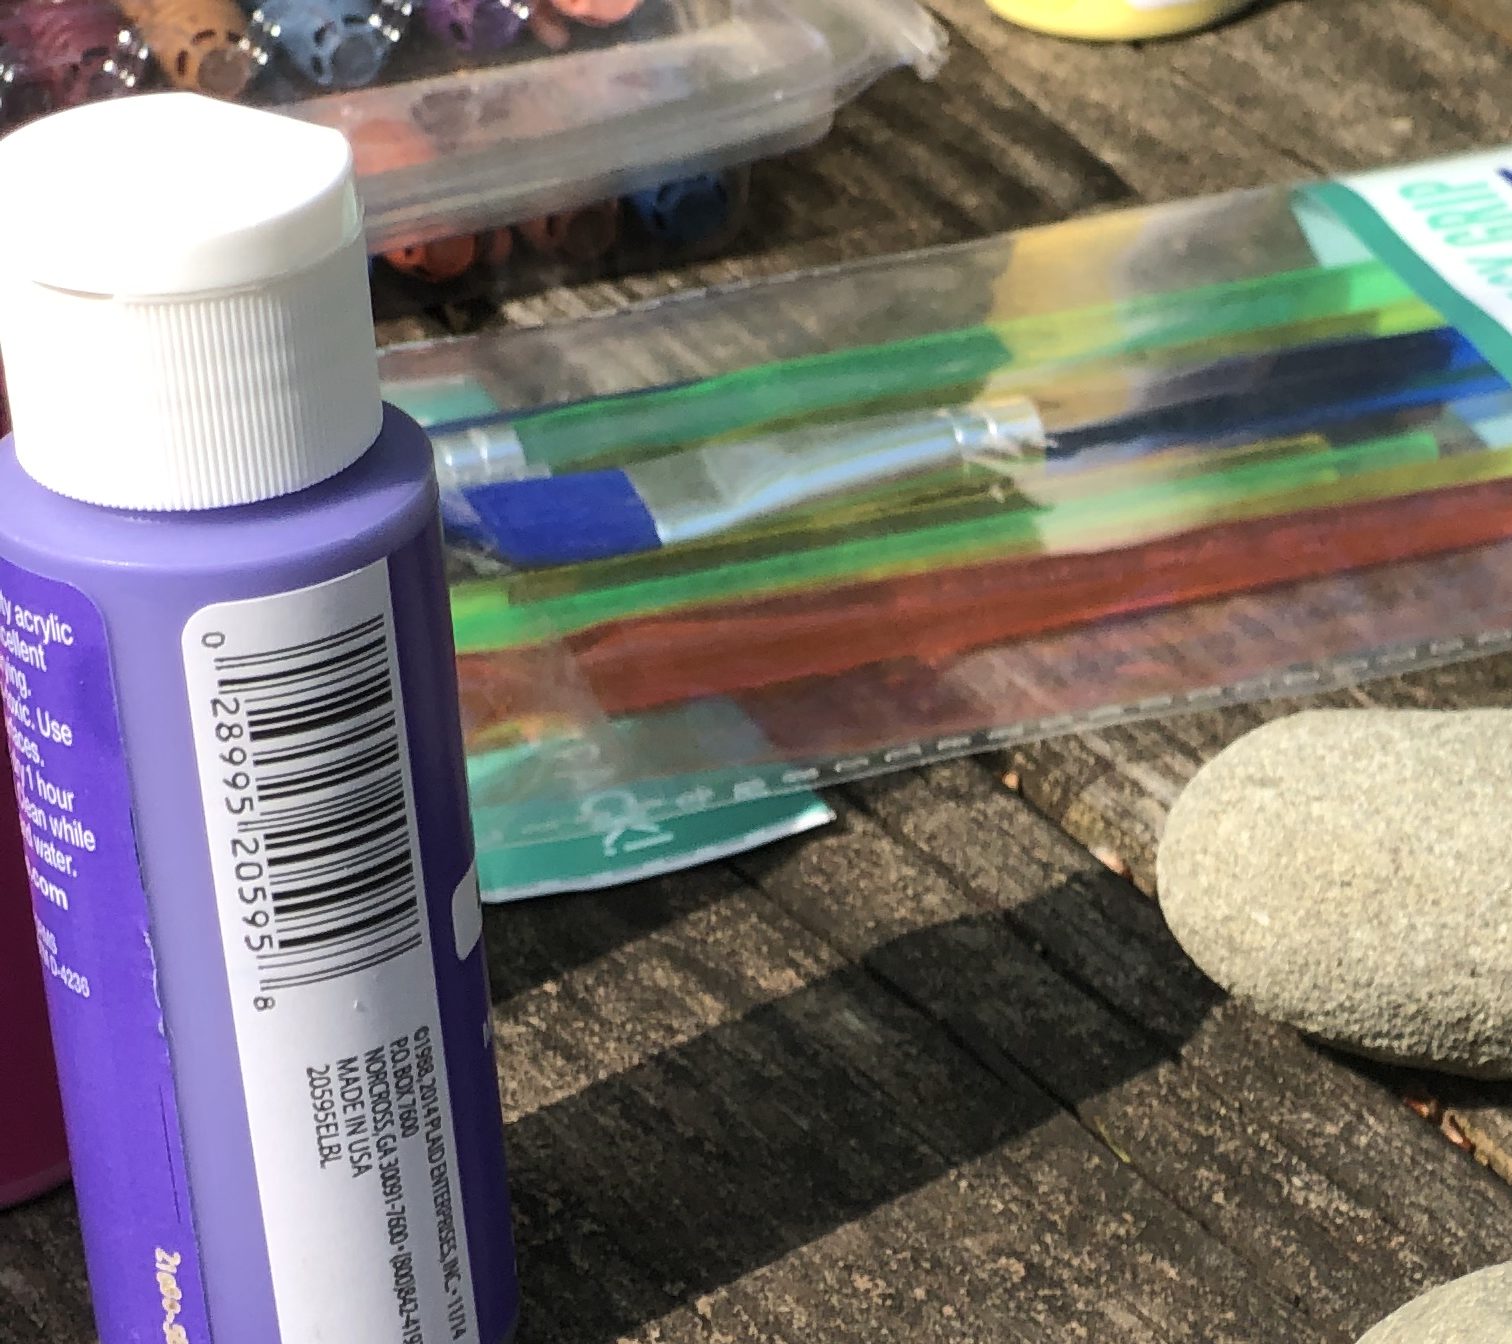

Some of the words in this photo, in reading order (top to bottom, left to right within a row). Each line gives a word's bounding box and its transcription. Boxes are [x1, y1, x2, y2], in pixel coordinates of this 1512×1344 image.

[14, 604, 74, 646] acrylic
[200, 631, 226, 649] 0
[36, 707, 73, 747] Use
[210, 697, 254, 816] 28995
[36, 770, 75, 812] hour
[49, 814, 97, 852] while
[32, 833, 78, 879] water.
[230, 836, 274, 951] 20595
[253, 995, 276, 1012] 8
[336, 1055, 366, 1115] MADE
[364, 1045, 395, 1137] NORCROSS,
[392, 1063, 416, 1101] BOX
[419, 1076, 440, 1120] 2014
[306, 1063, 343, 1170] 20595ELBL
[344, 1113, 368, 1137] IN
[397, 1097, 420, 1139] 7600
[348, 1137, 373, 1179] USA
[375, 1133, 398, 1161] GA
[424, 1115, 446, 1165] PLAID
[378, 1156, 409, 1246] 30091-7600
